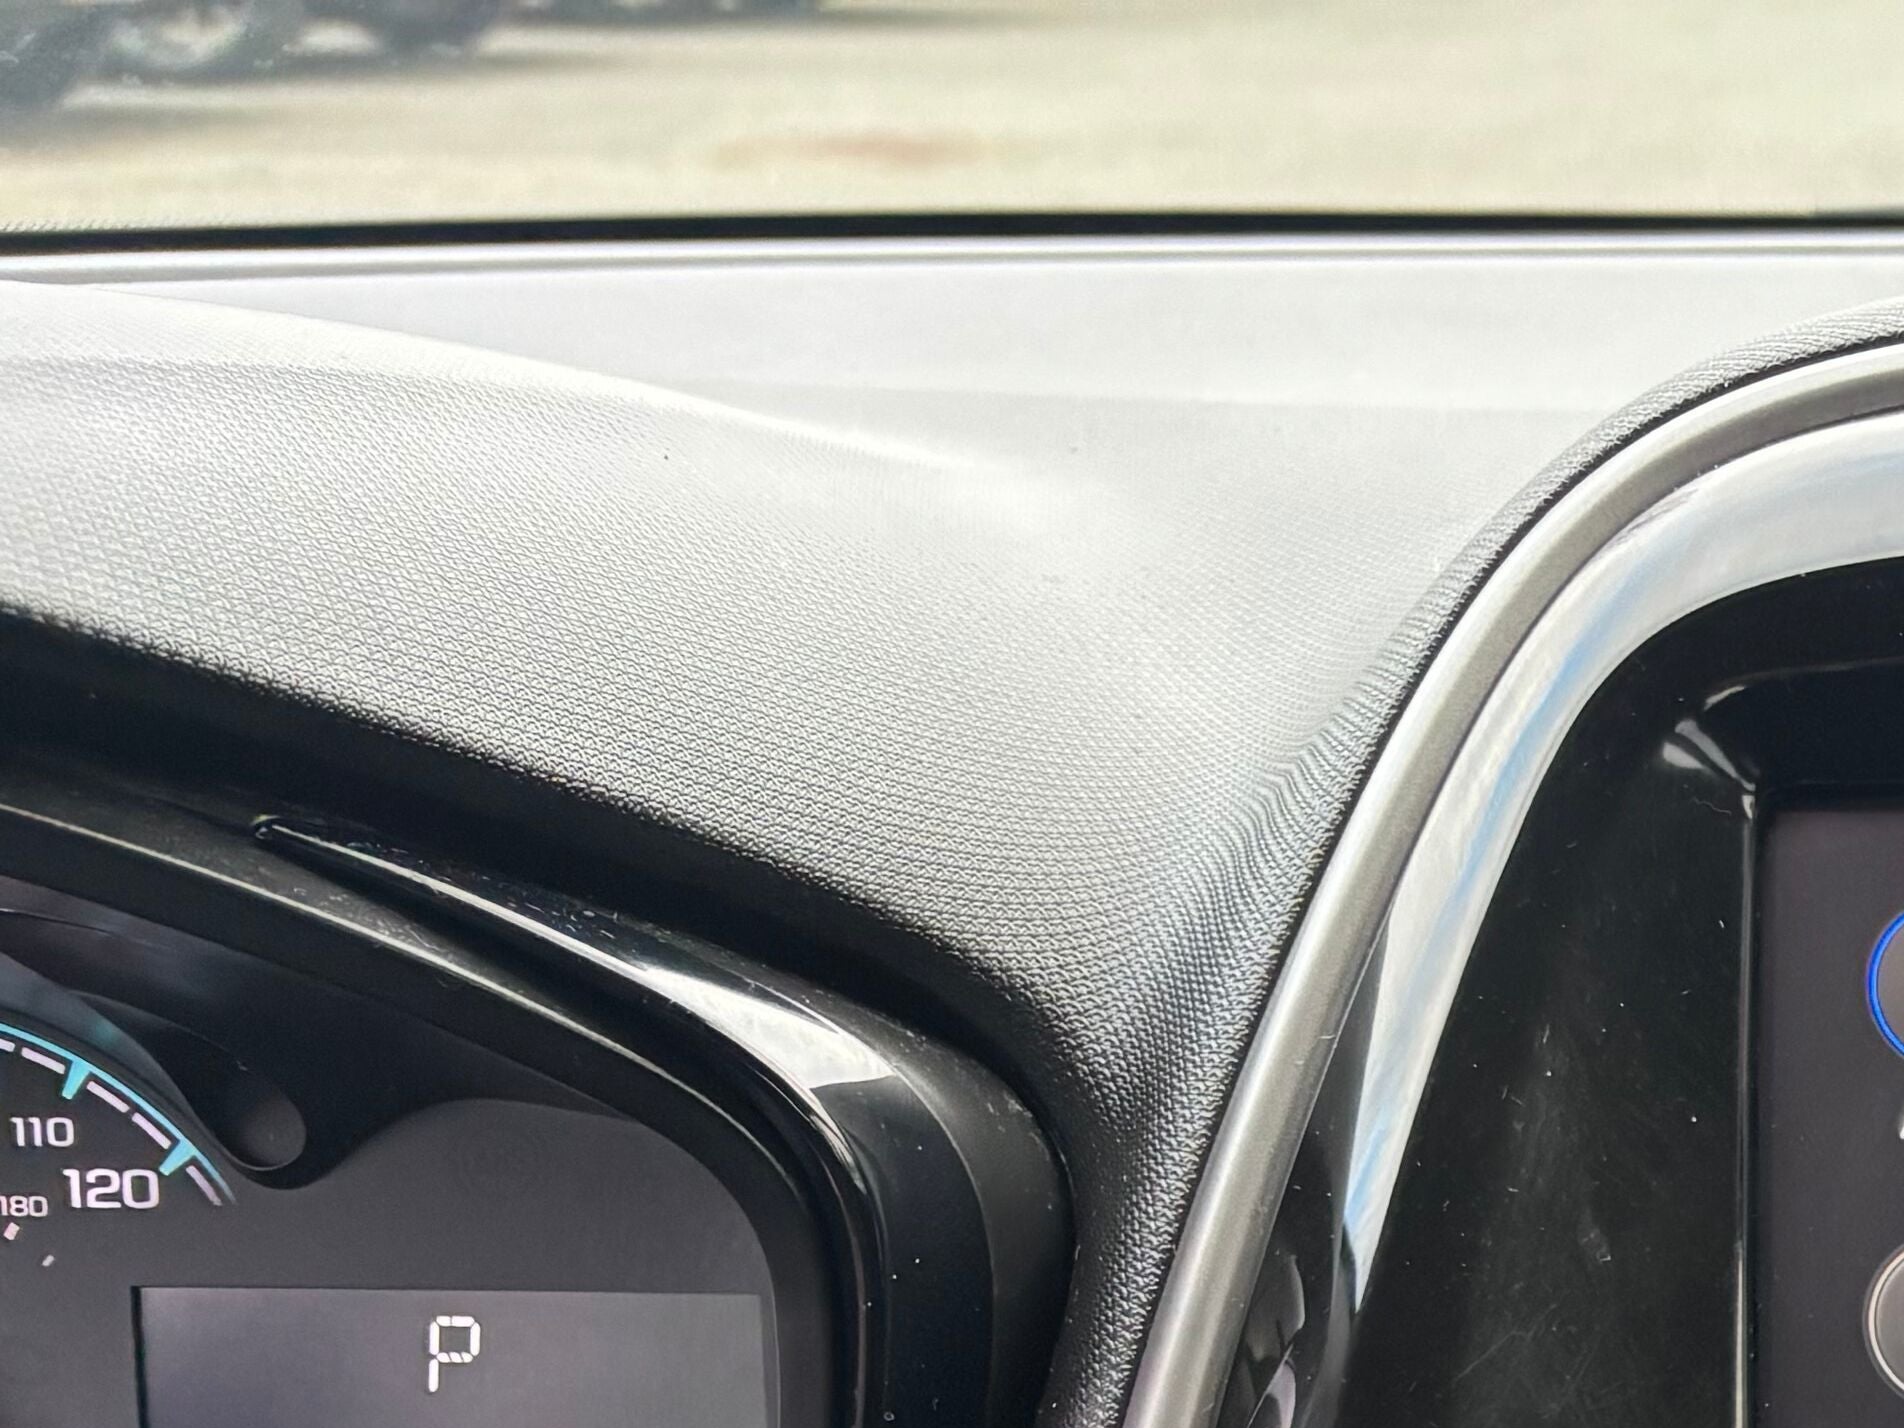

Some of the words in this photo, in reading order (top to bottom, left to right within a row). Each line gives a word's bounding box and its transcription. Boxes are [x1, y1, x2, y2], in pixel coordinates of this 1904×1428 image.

[10, 1116, 75, 1147] 110
[0, 1195, 49, 1218] 180
[62, 1168, 160, 1210] 120
[428, 1315, 481, 1393] P
